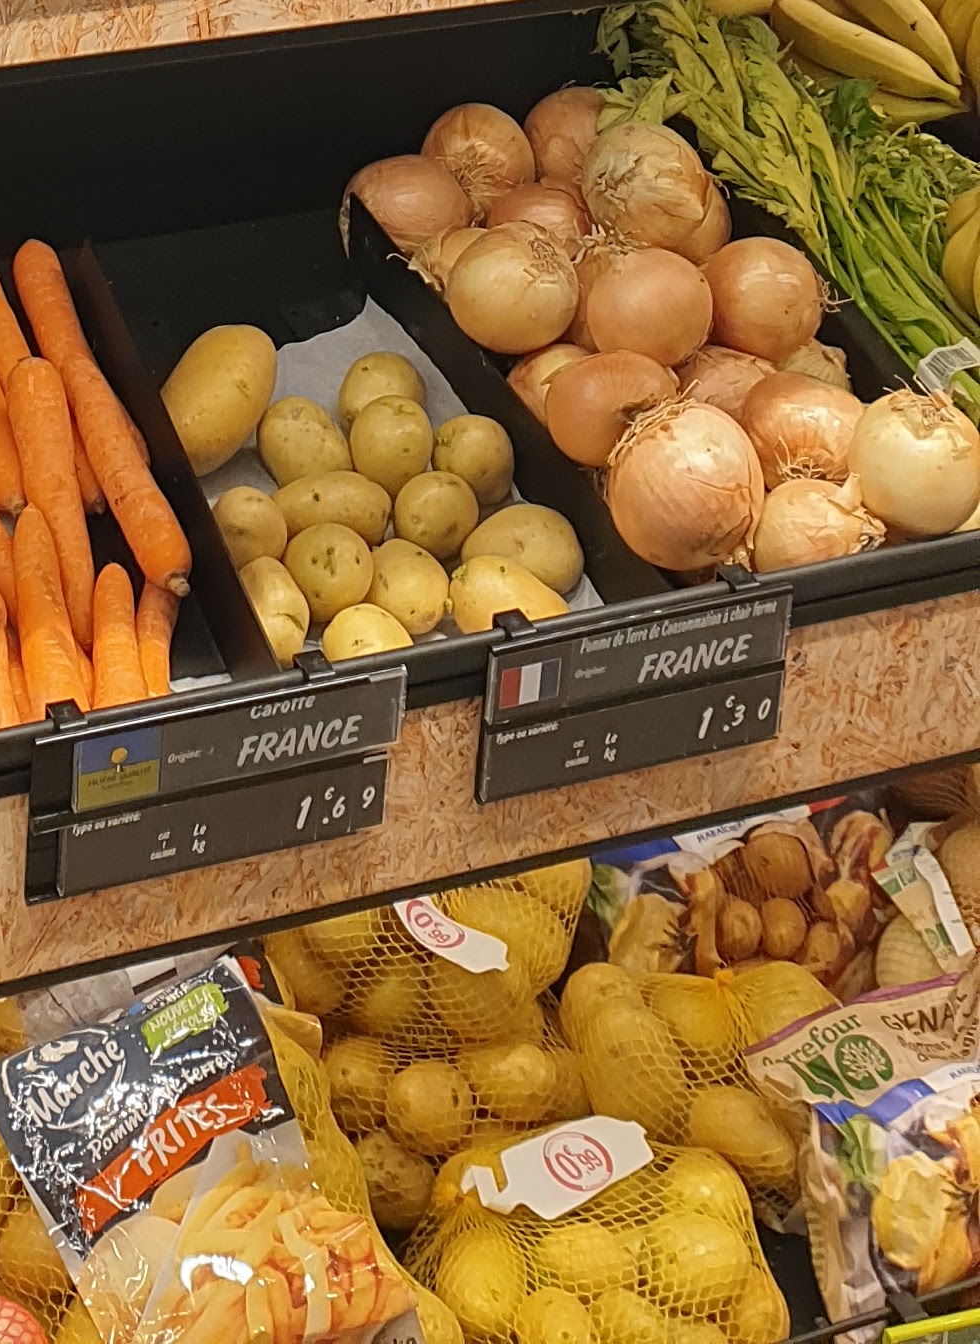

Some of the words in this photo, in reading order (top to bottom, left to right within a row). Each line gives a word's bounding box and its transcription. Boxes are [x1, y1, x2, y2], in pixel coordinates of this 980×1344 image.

[625, 626, 647, 645] Terre
[638, 634, 753, 684] FRANCE
[237, 715, 362, 768] FRANCE
[24, 1041, 125, 1127] Marché
[136, 1094, 227, 1176] FRITES
